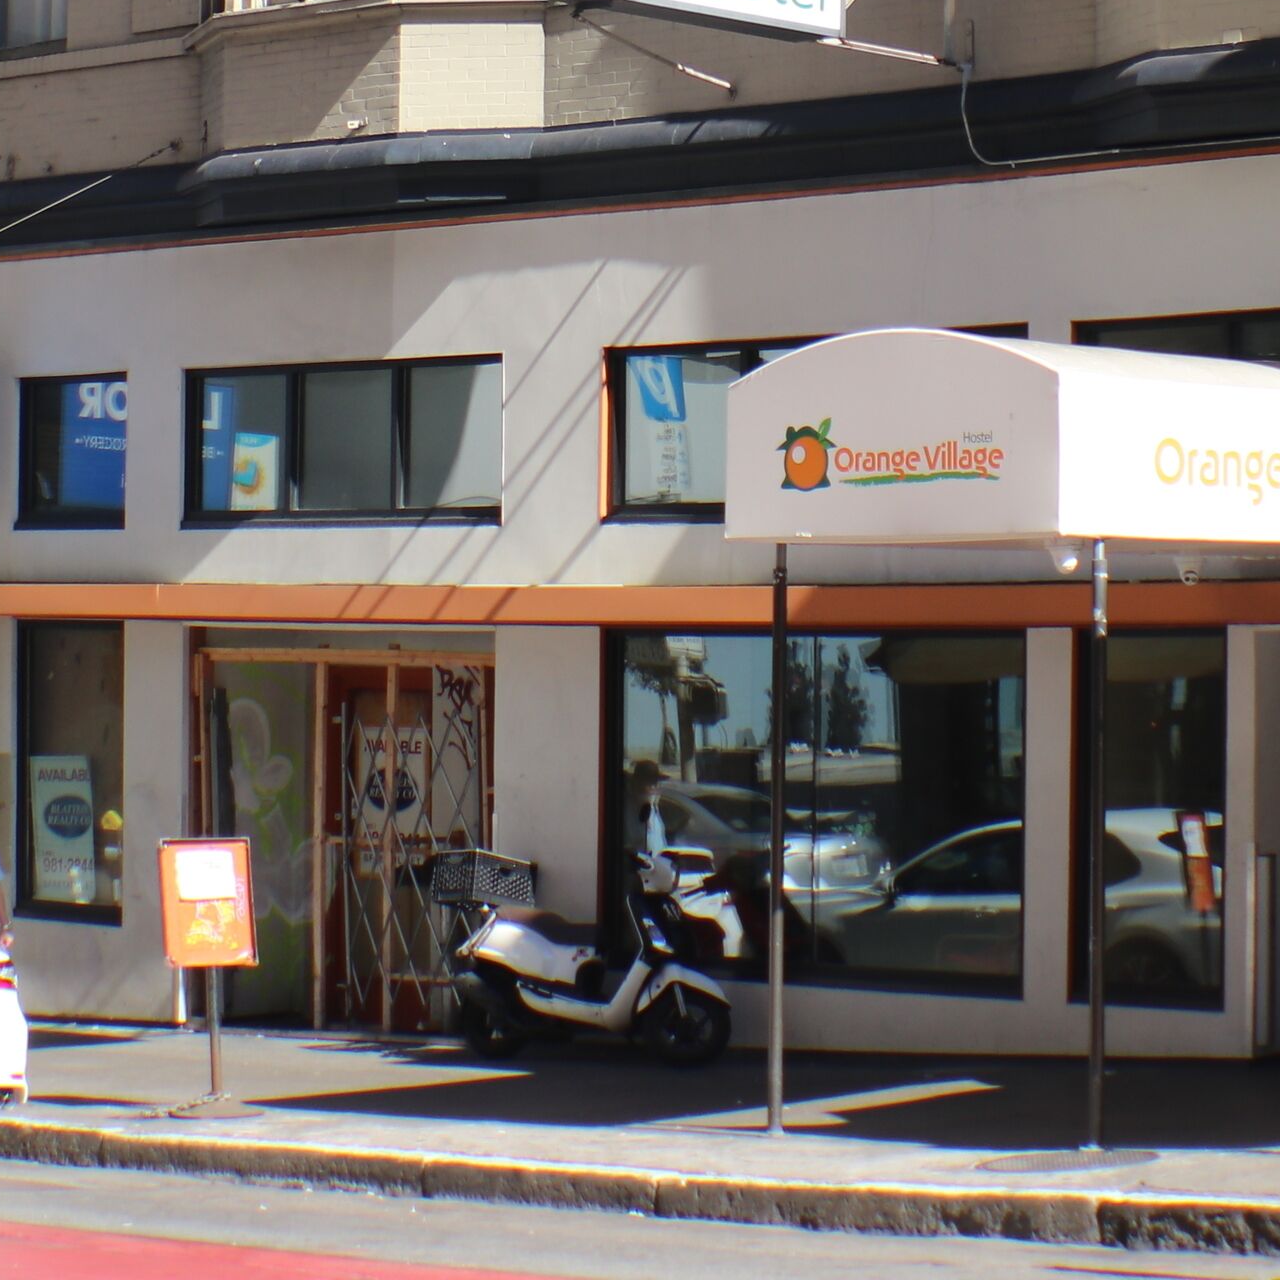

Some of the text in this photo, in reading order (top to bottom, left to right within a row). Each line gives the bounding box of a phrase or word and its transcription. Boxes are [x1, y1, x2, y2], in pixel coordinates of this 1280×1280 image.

[962, 430, 993, 443] Hostel
[834, 440, 1004, 480] Orange Village
